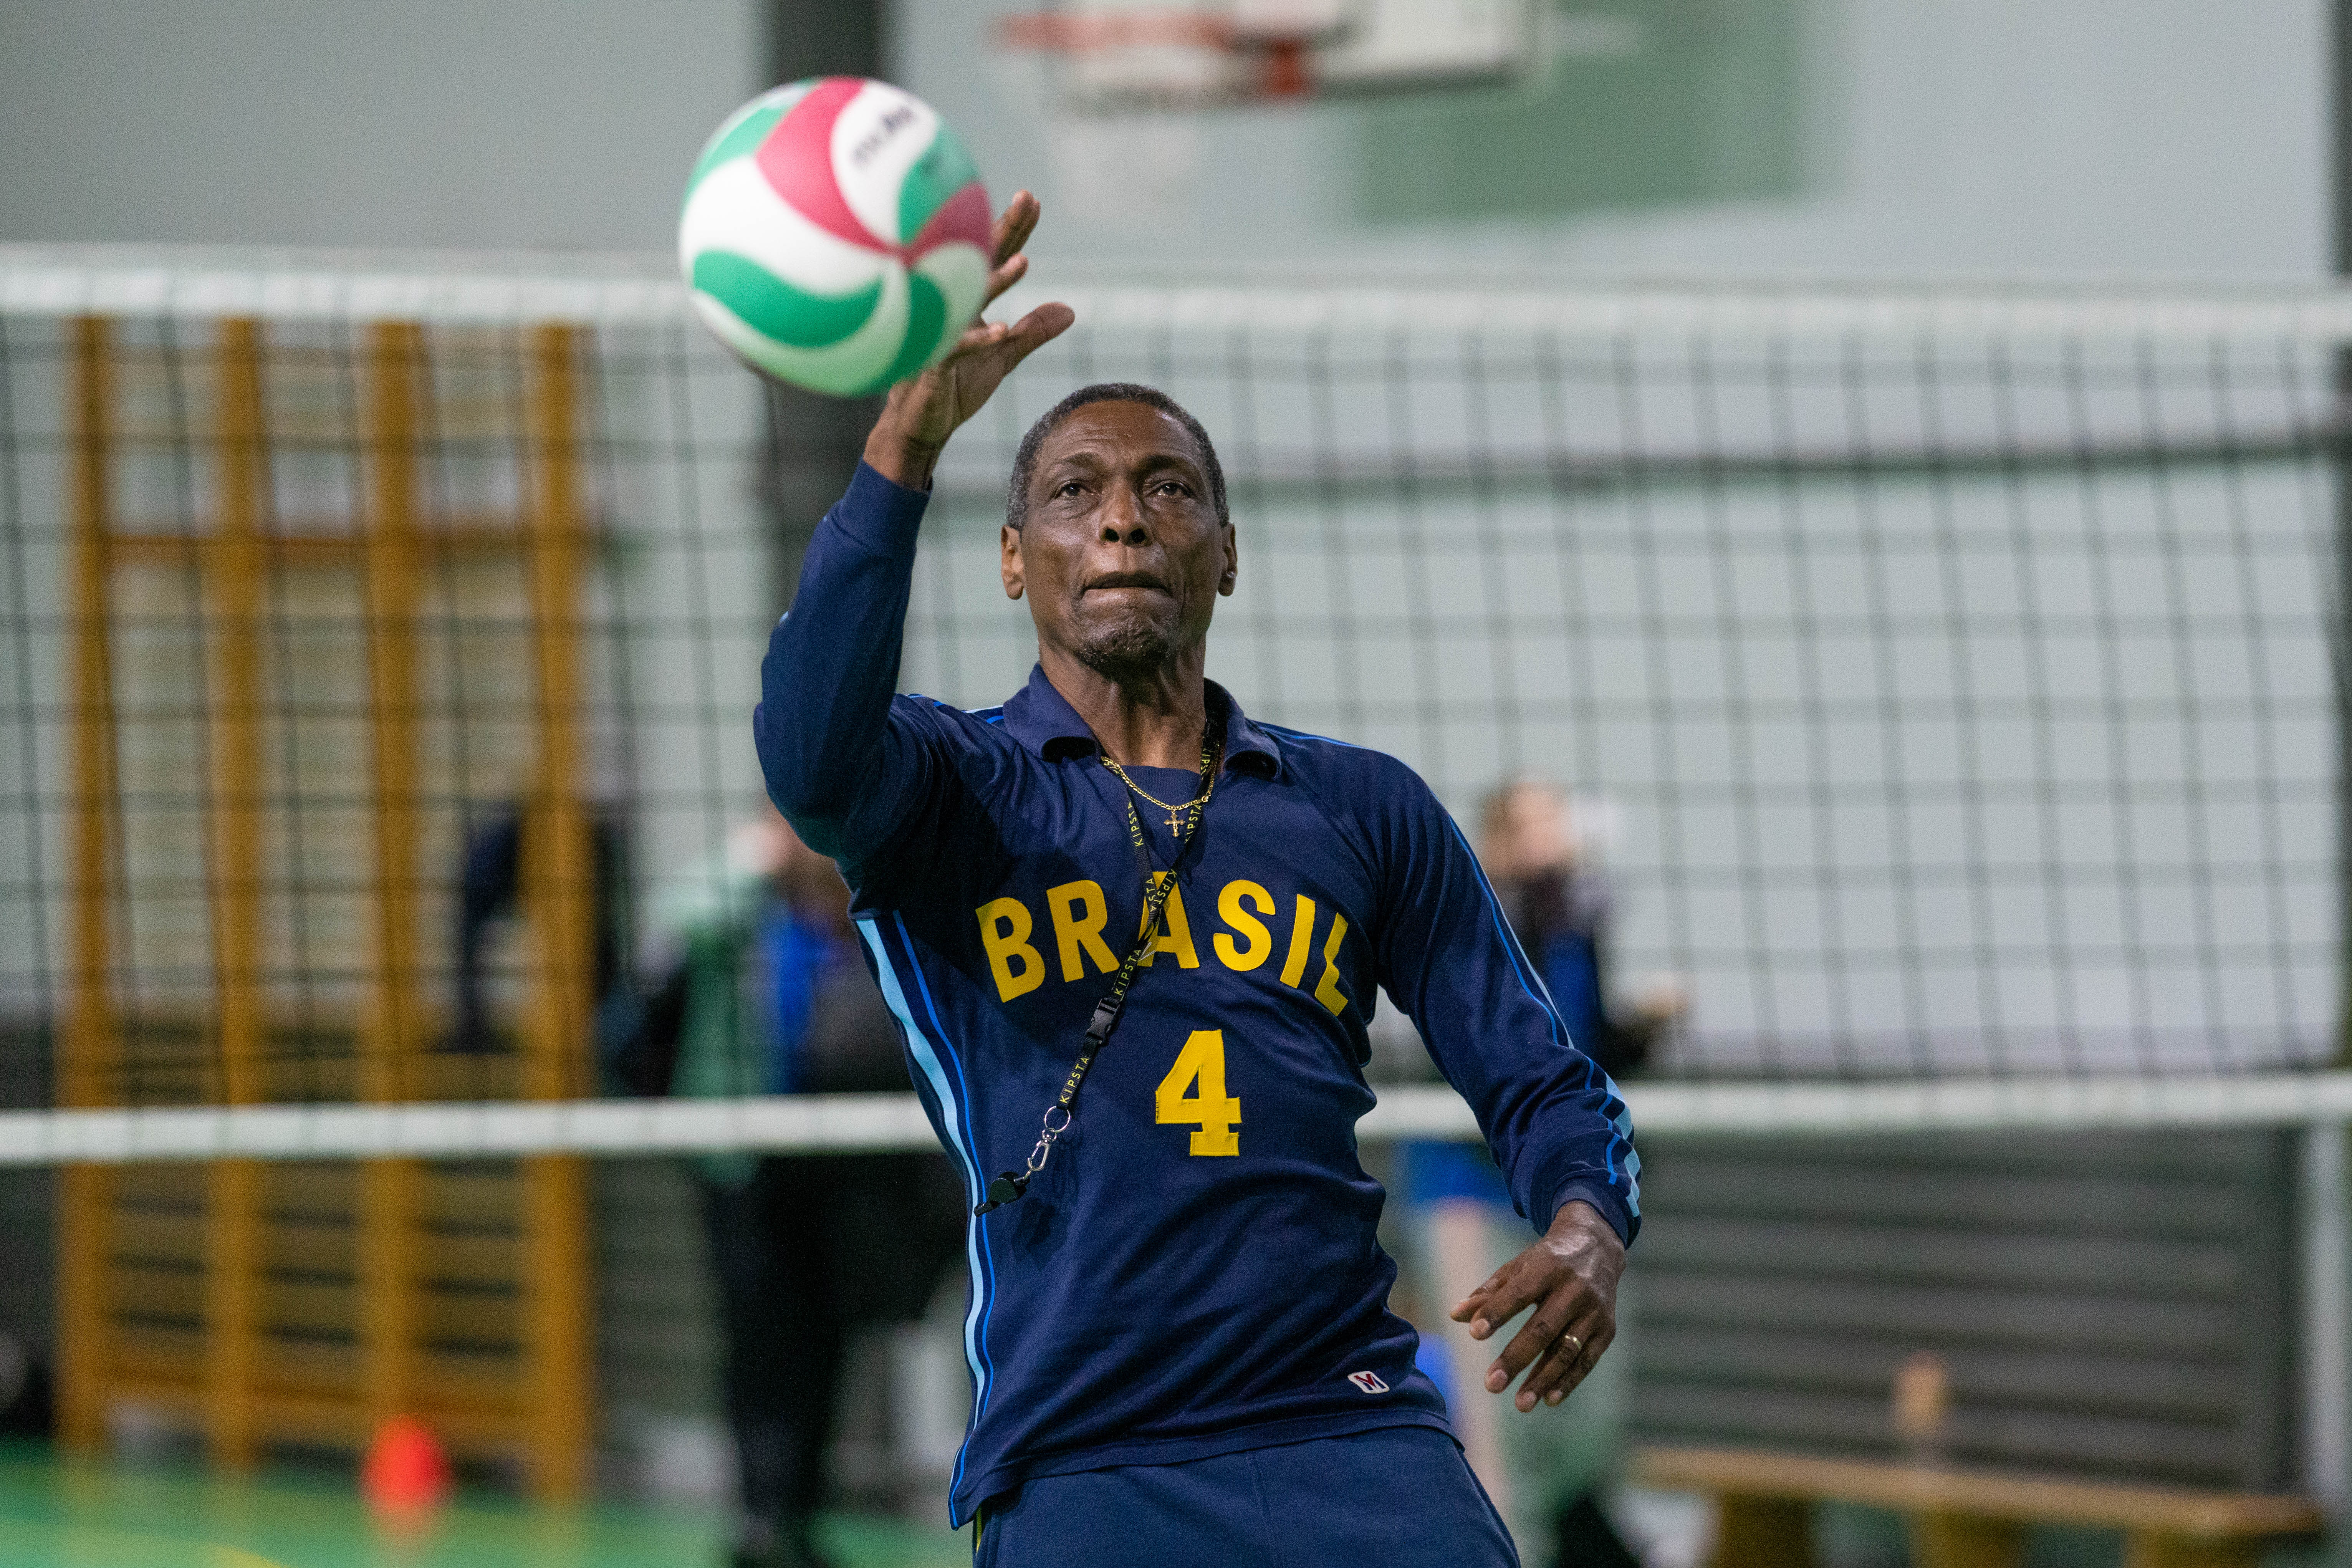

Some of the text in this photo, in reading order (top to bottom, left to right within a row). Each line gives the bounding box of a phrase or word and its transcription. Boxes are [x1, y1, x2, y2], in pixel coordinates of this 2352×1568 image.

[1128, 801, 1144, 846] KIPSTA
[1149, 869, 1177, 912] KIPSTA
[975, 871, 1349, 1016] BRASIL
[1114, 950, 1142, 995] KIPSTA
[1059, 1058, 1089, 1103] KIPSTA
[1155, 1029, 1242, 1156] 4
